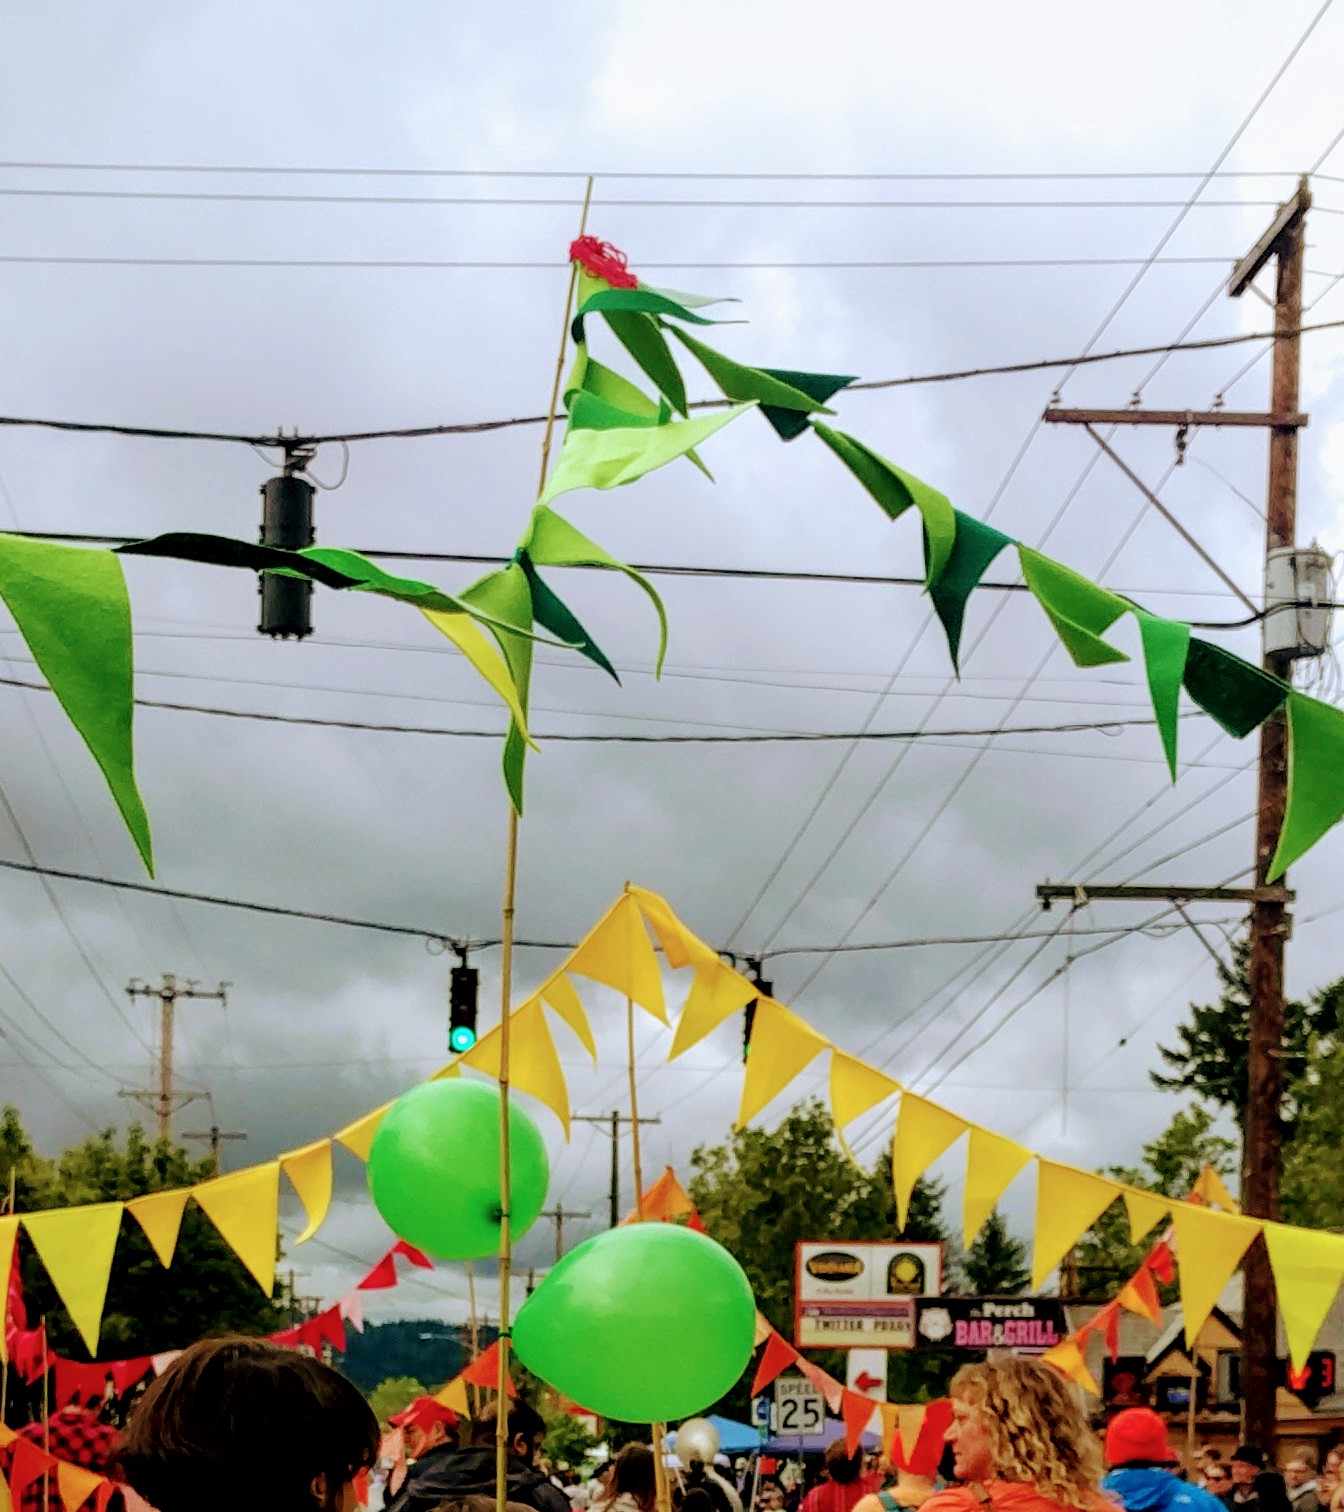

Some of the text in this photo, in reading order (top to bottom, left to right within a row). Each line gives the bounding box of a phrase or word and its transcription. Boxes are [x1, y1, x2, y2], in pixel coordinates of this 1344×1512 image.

[982, 1302, 1035, 1317] Perch
[781, 1383, 819, 1396] SPEE
[782, 1399, 820, 1429] 25
